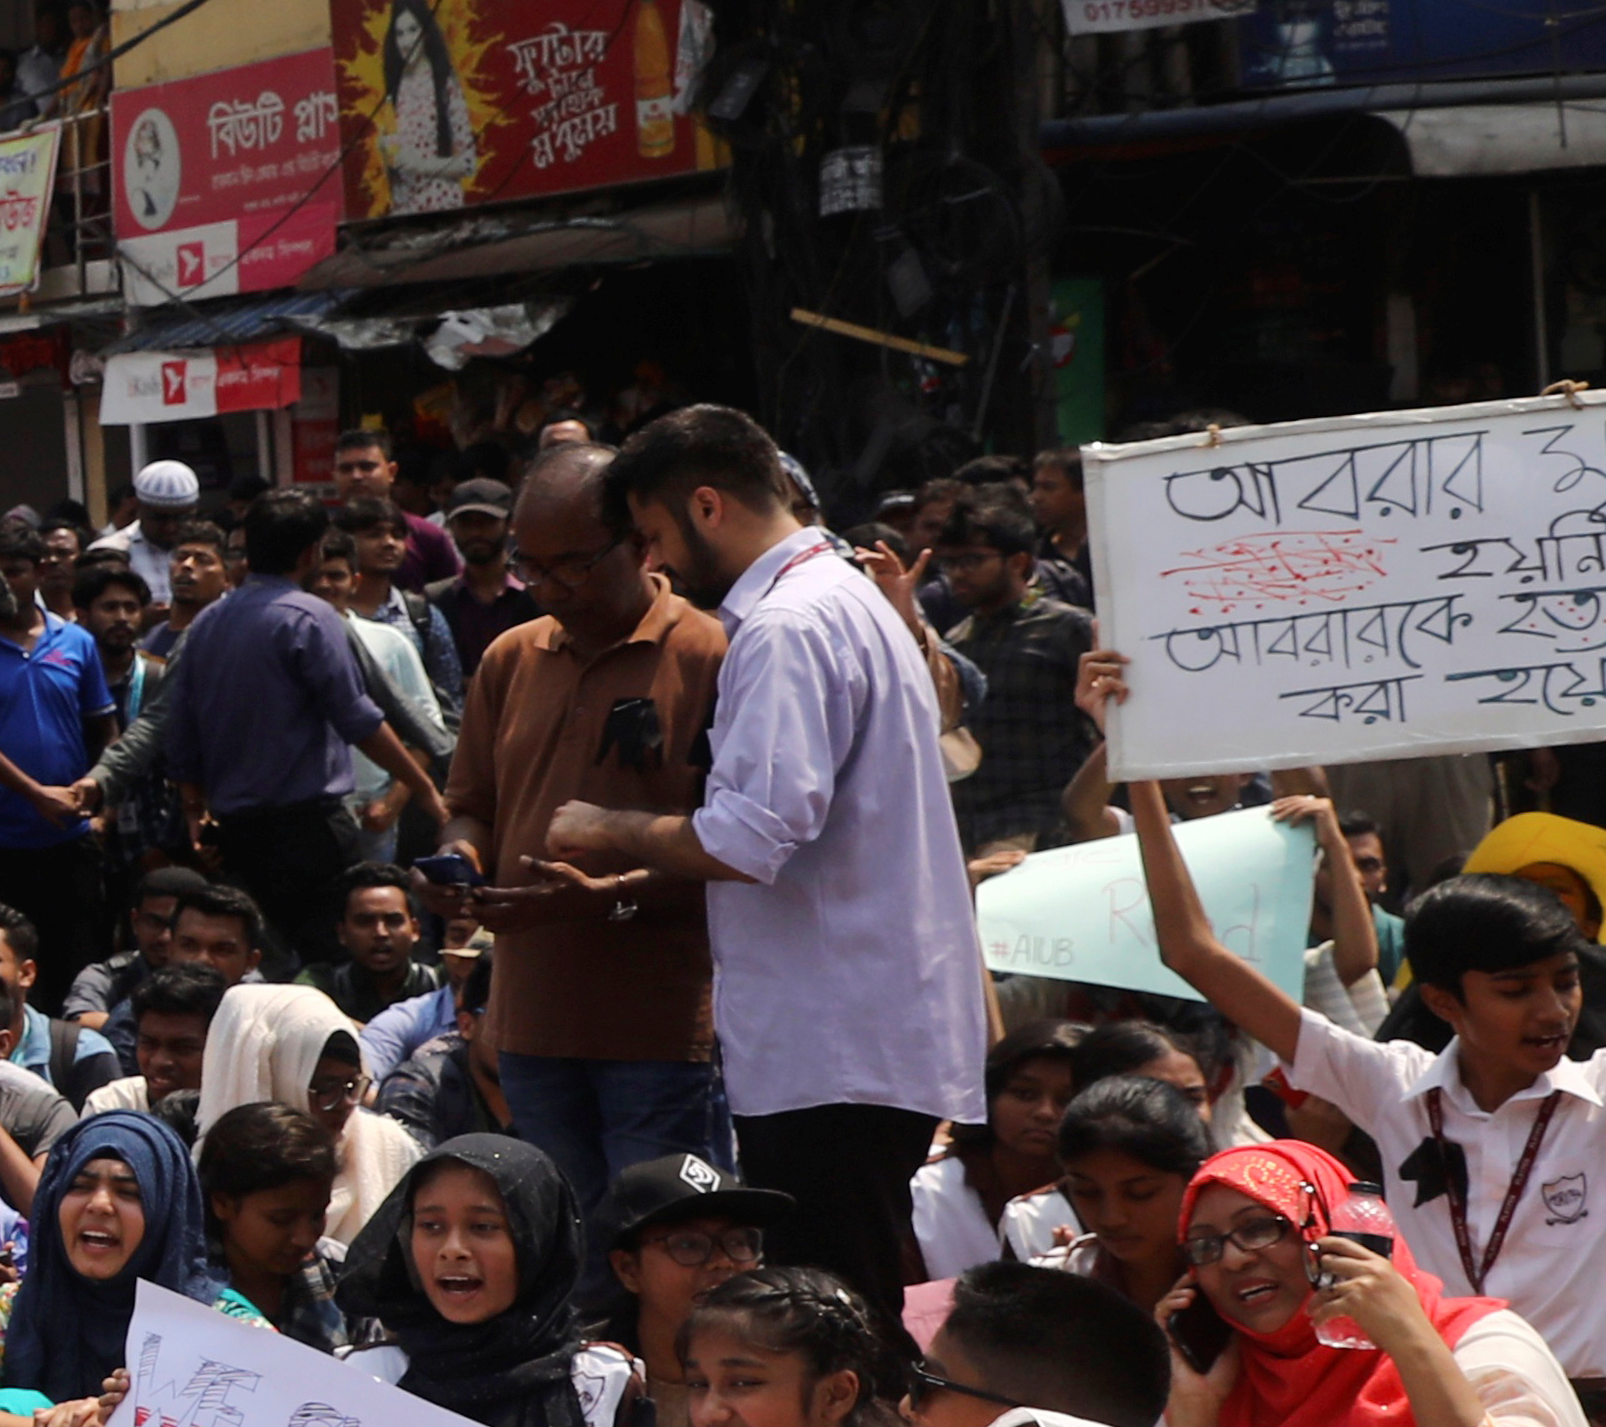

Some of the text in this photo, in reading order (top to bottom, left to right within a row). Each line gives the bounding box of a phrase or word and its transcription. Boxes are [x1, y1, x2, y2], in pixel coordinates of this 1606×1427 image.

[207, 90, 285, 160] বিউটি
[1278, 673, 1425, 725] করা
[989, 933, 1074, 967] #AIUB
